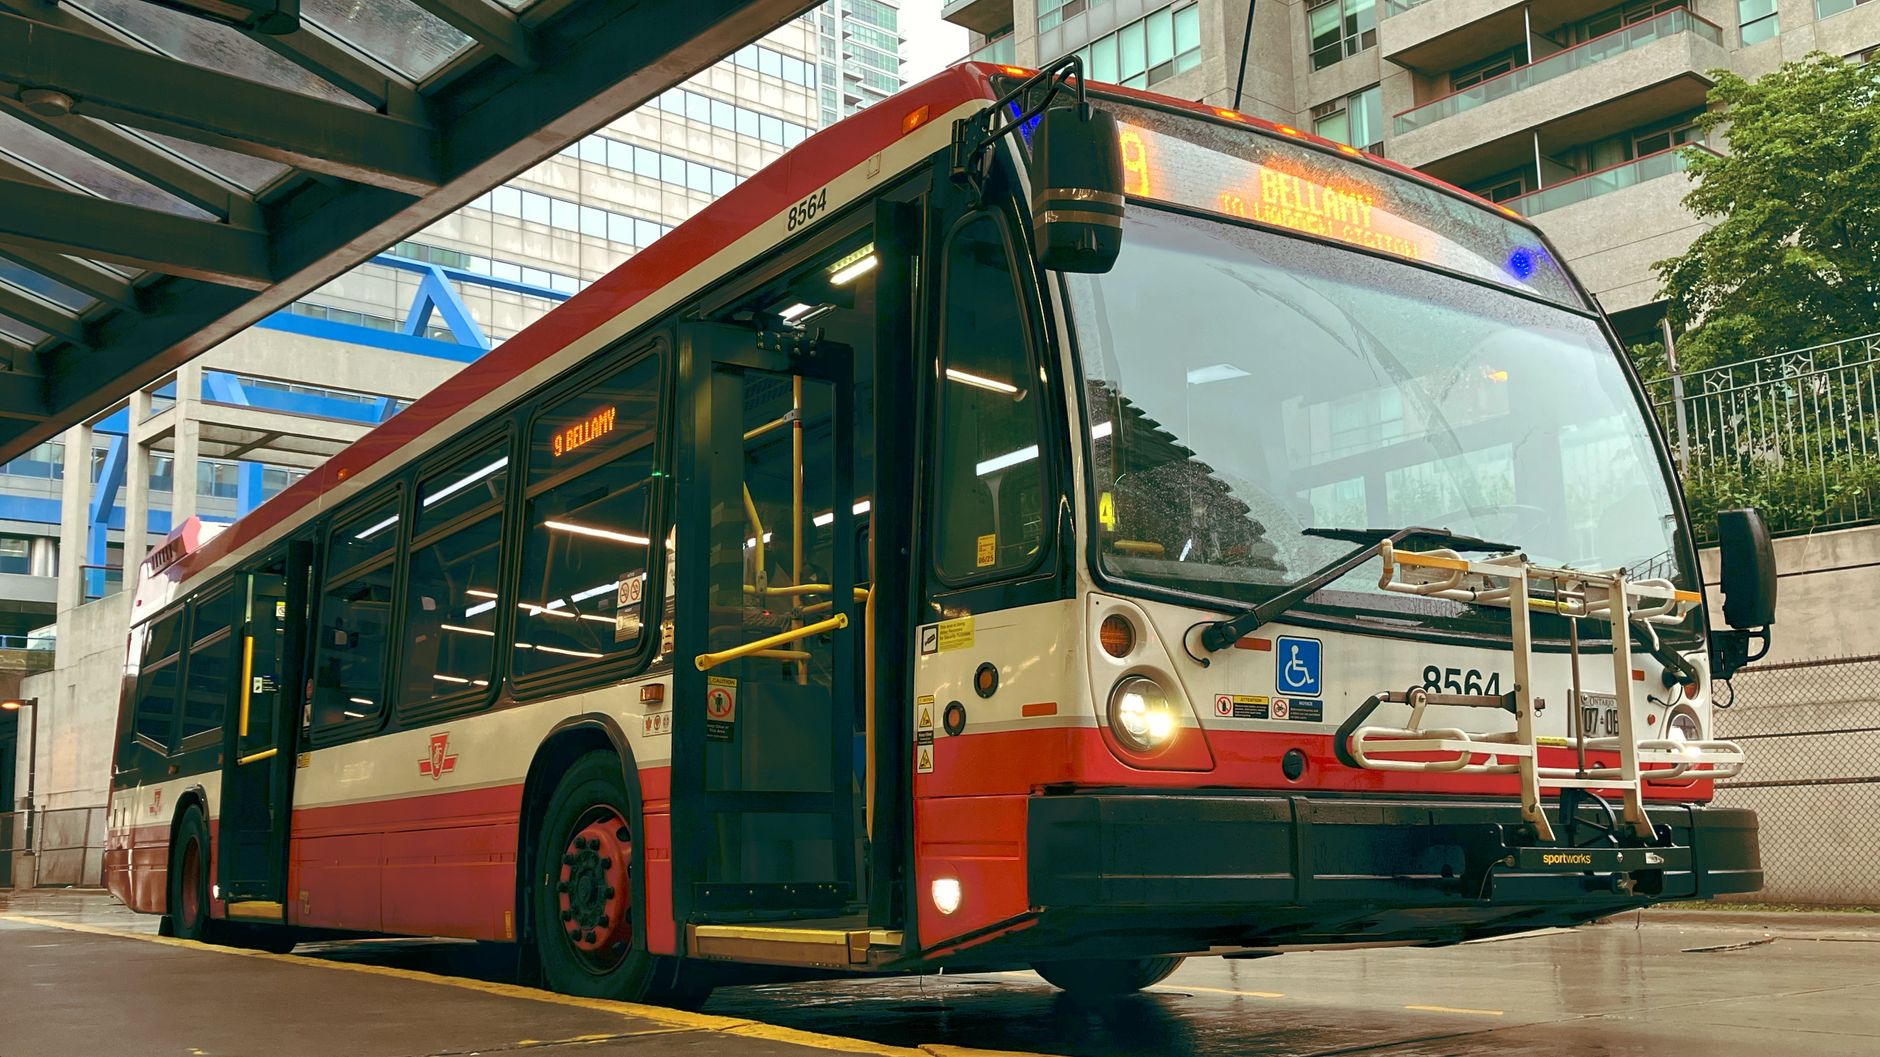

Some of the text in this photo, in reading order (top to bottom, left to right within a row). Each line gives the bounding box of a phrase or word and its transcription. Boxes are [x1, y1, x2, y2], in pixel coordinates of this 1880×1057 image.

[1120, 129, 1374, 229] 9 BELLAMY
[787, 187, 827, 232] 8564
[554, 406, 616, 457] 9 BELLAMY
[1422, 665, 1501, 696] 8564
[1543, 852, 1592, 865] sportworks
